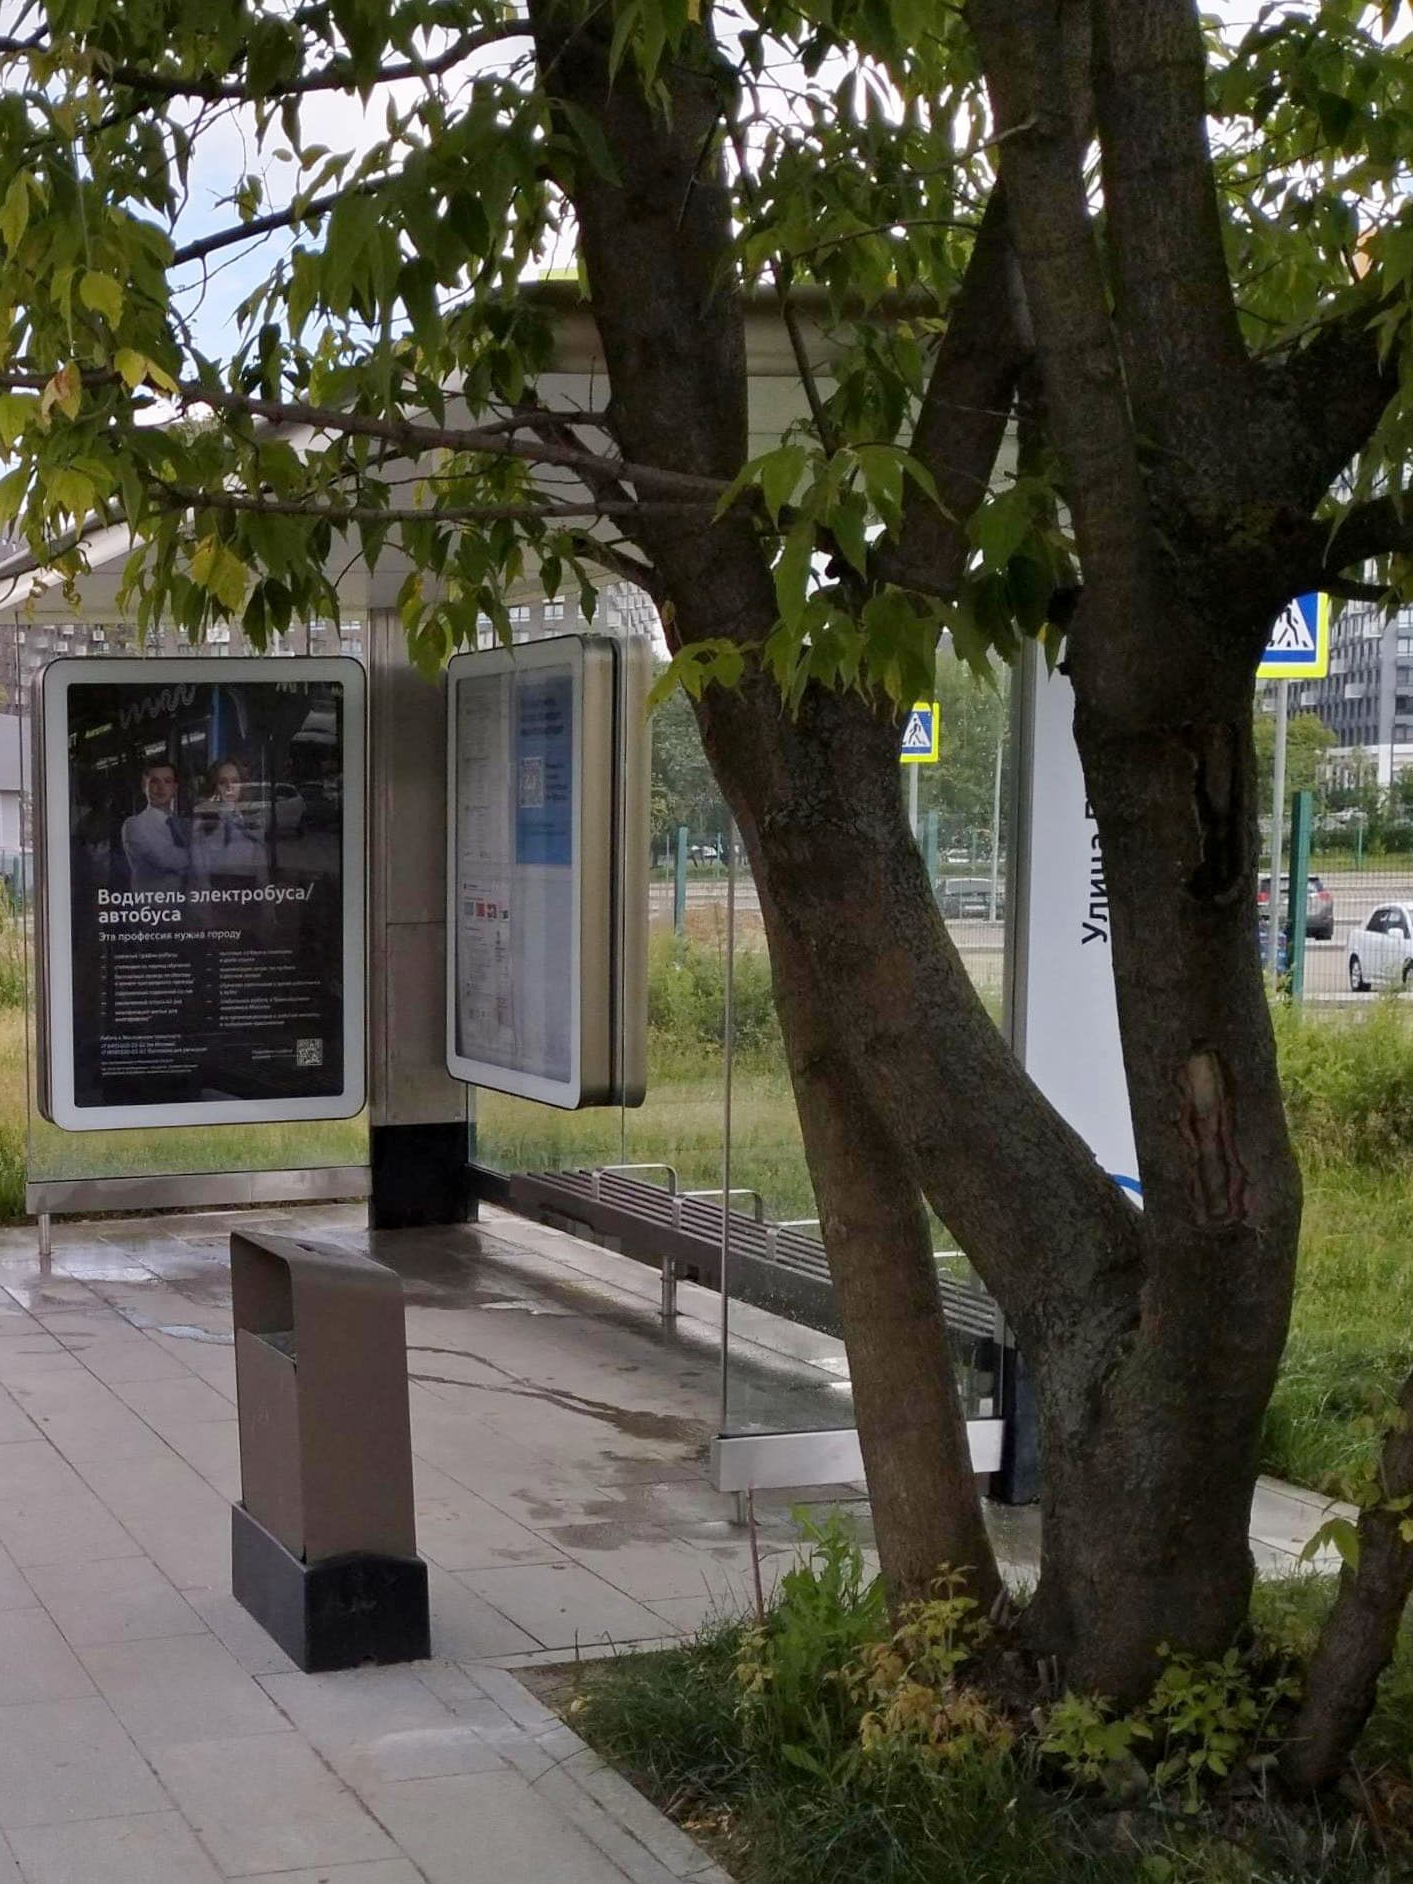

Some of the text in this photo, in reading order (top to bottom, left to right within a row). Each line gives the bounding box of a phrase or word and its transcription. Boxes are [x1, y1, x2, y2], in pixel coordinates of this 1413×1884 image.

[98, 882, 315, 906] Водитель электробуса/
[98, 907, 182, 926] автобуса
[98, 932, 117, 942] Эта
[118, 930, 172, 943] профессия
[207, 929, 242, 941] городу
